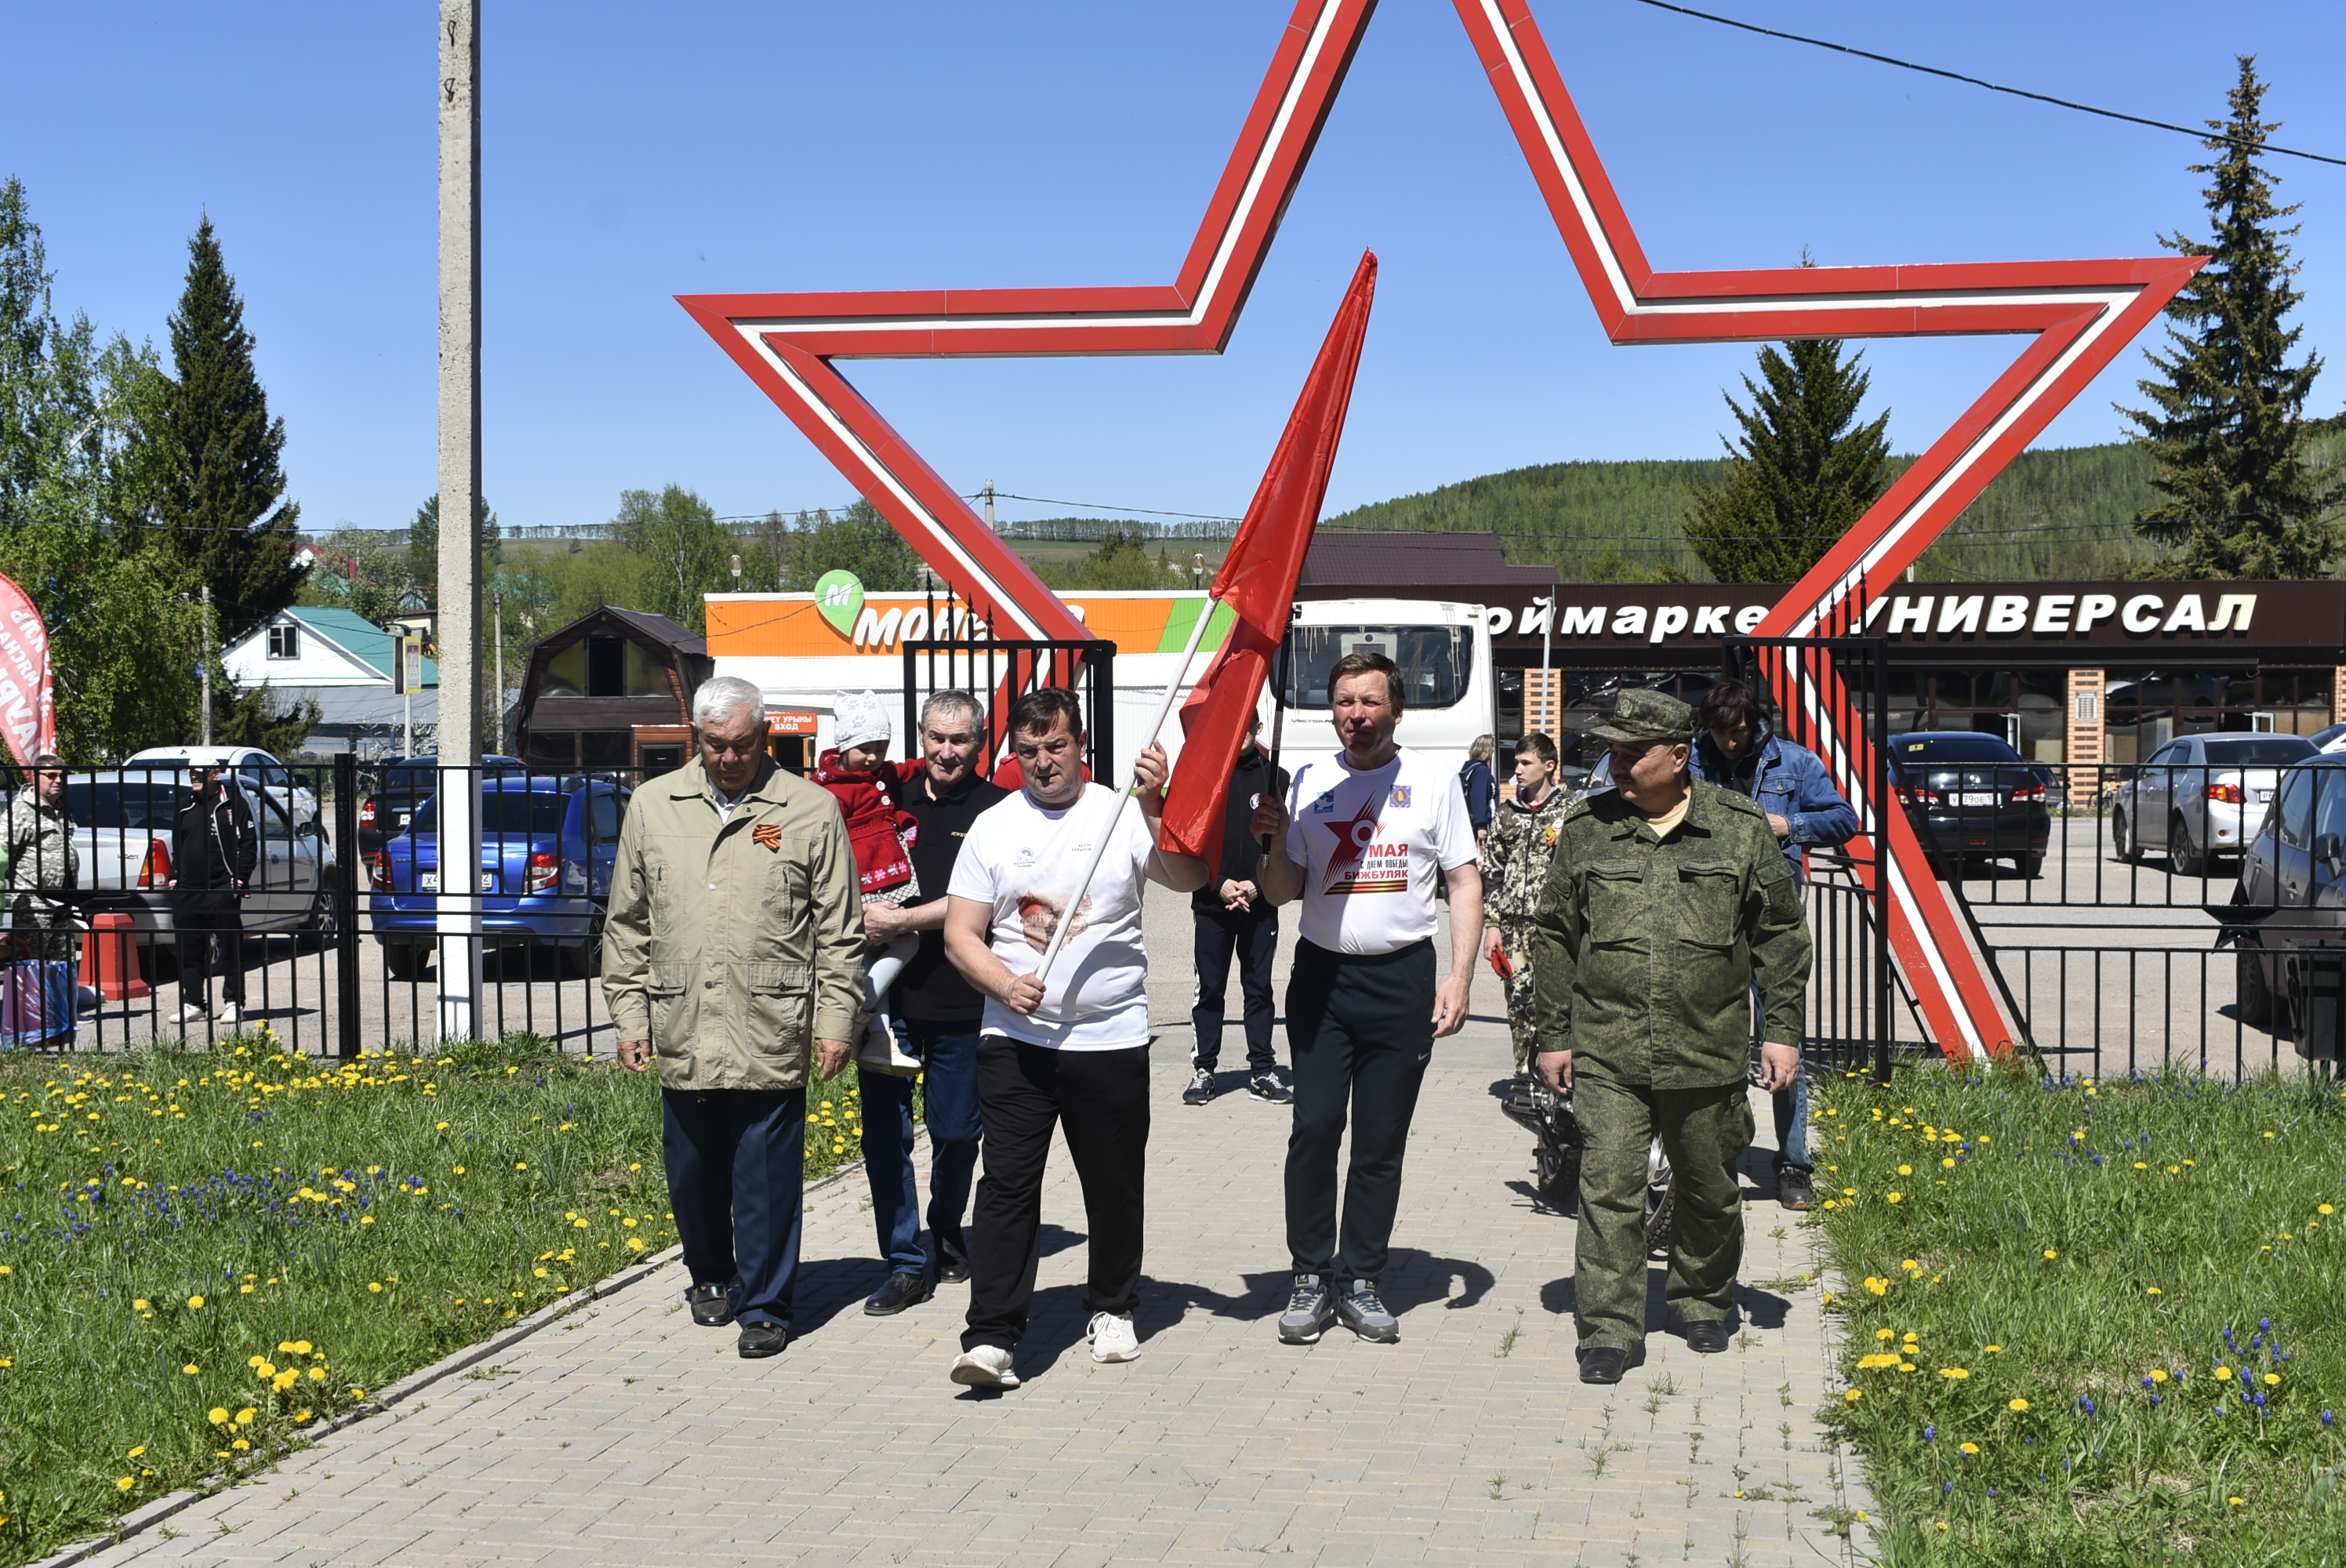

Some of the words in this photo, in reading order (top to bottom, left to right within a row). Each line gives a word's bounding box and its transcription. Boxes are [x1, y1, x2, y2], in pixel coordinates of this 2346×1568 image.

[1488, 596, 1770, 644] оймарке
[1369, 844, 1409, 858] МАЯ
[1344, 869, 1408, 880] БИЖБУЛЯК
